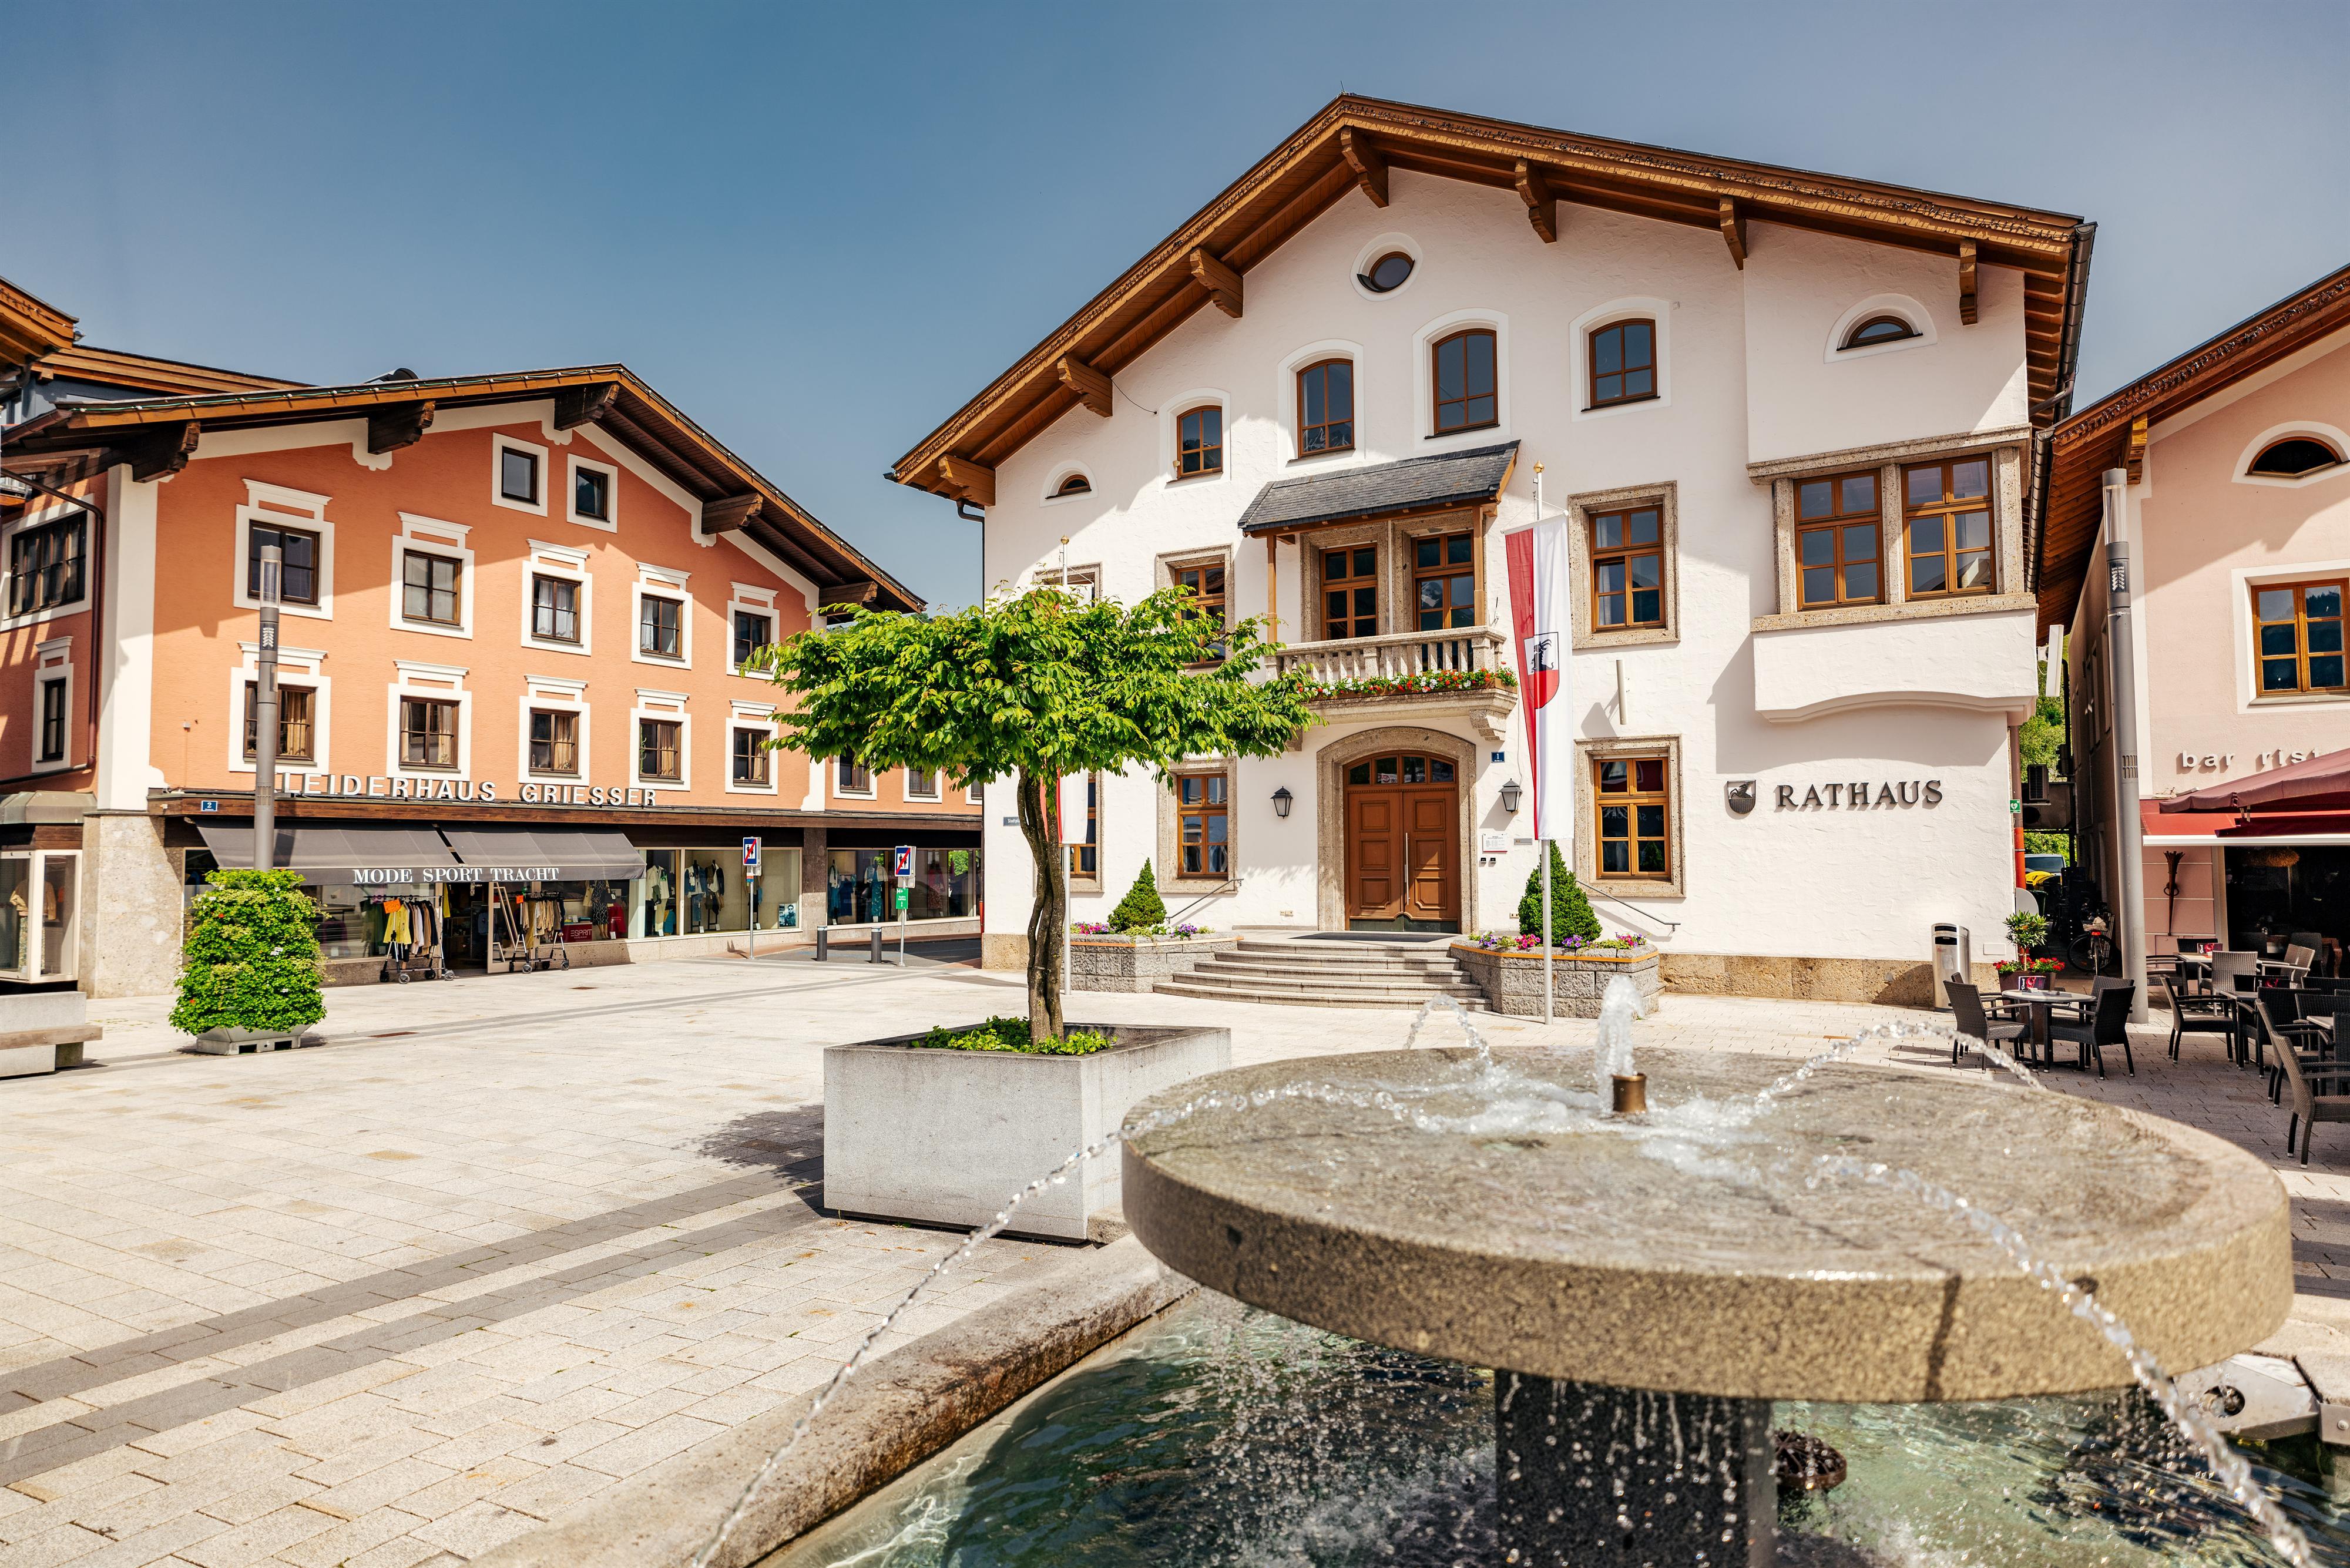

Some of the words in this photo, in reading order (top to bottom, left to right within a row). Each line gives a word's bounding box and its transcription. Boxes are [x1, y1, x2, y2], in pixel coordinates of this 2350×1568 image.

[2183, 750, 2235, 767] bar
[274, 772, 496, 801] LEIDERHAUS
[519, 783, 657, 807] GRIESSER
[1777, 780, 1943, 807] RATHAUS
[352, 869, 412, 884] MODE
[423, 868, 482, 882] SPORT
[490, 867, 559, 882] TRACHT
